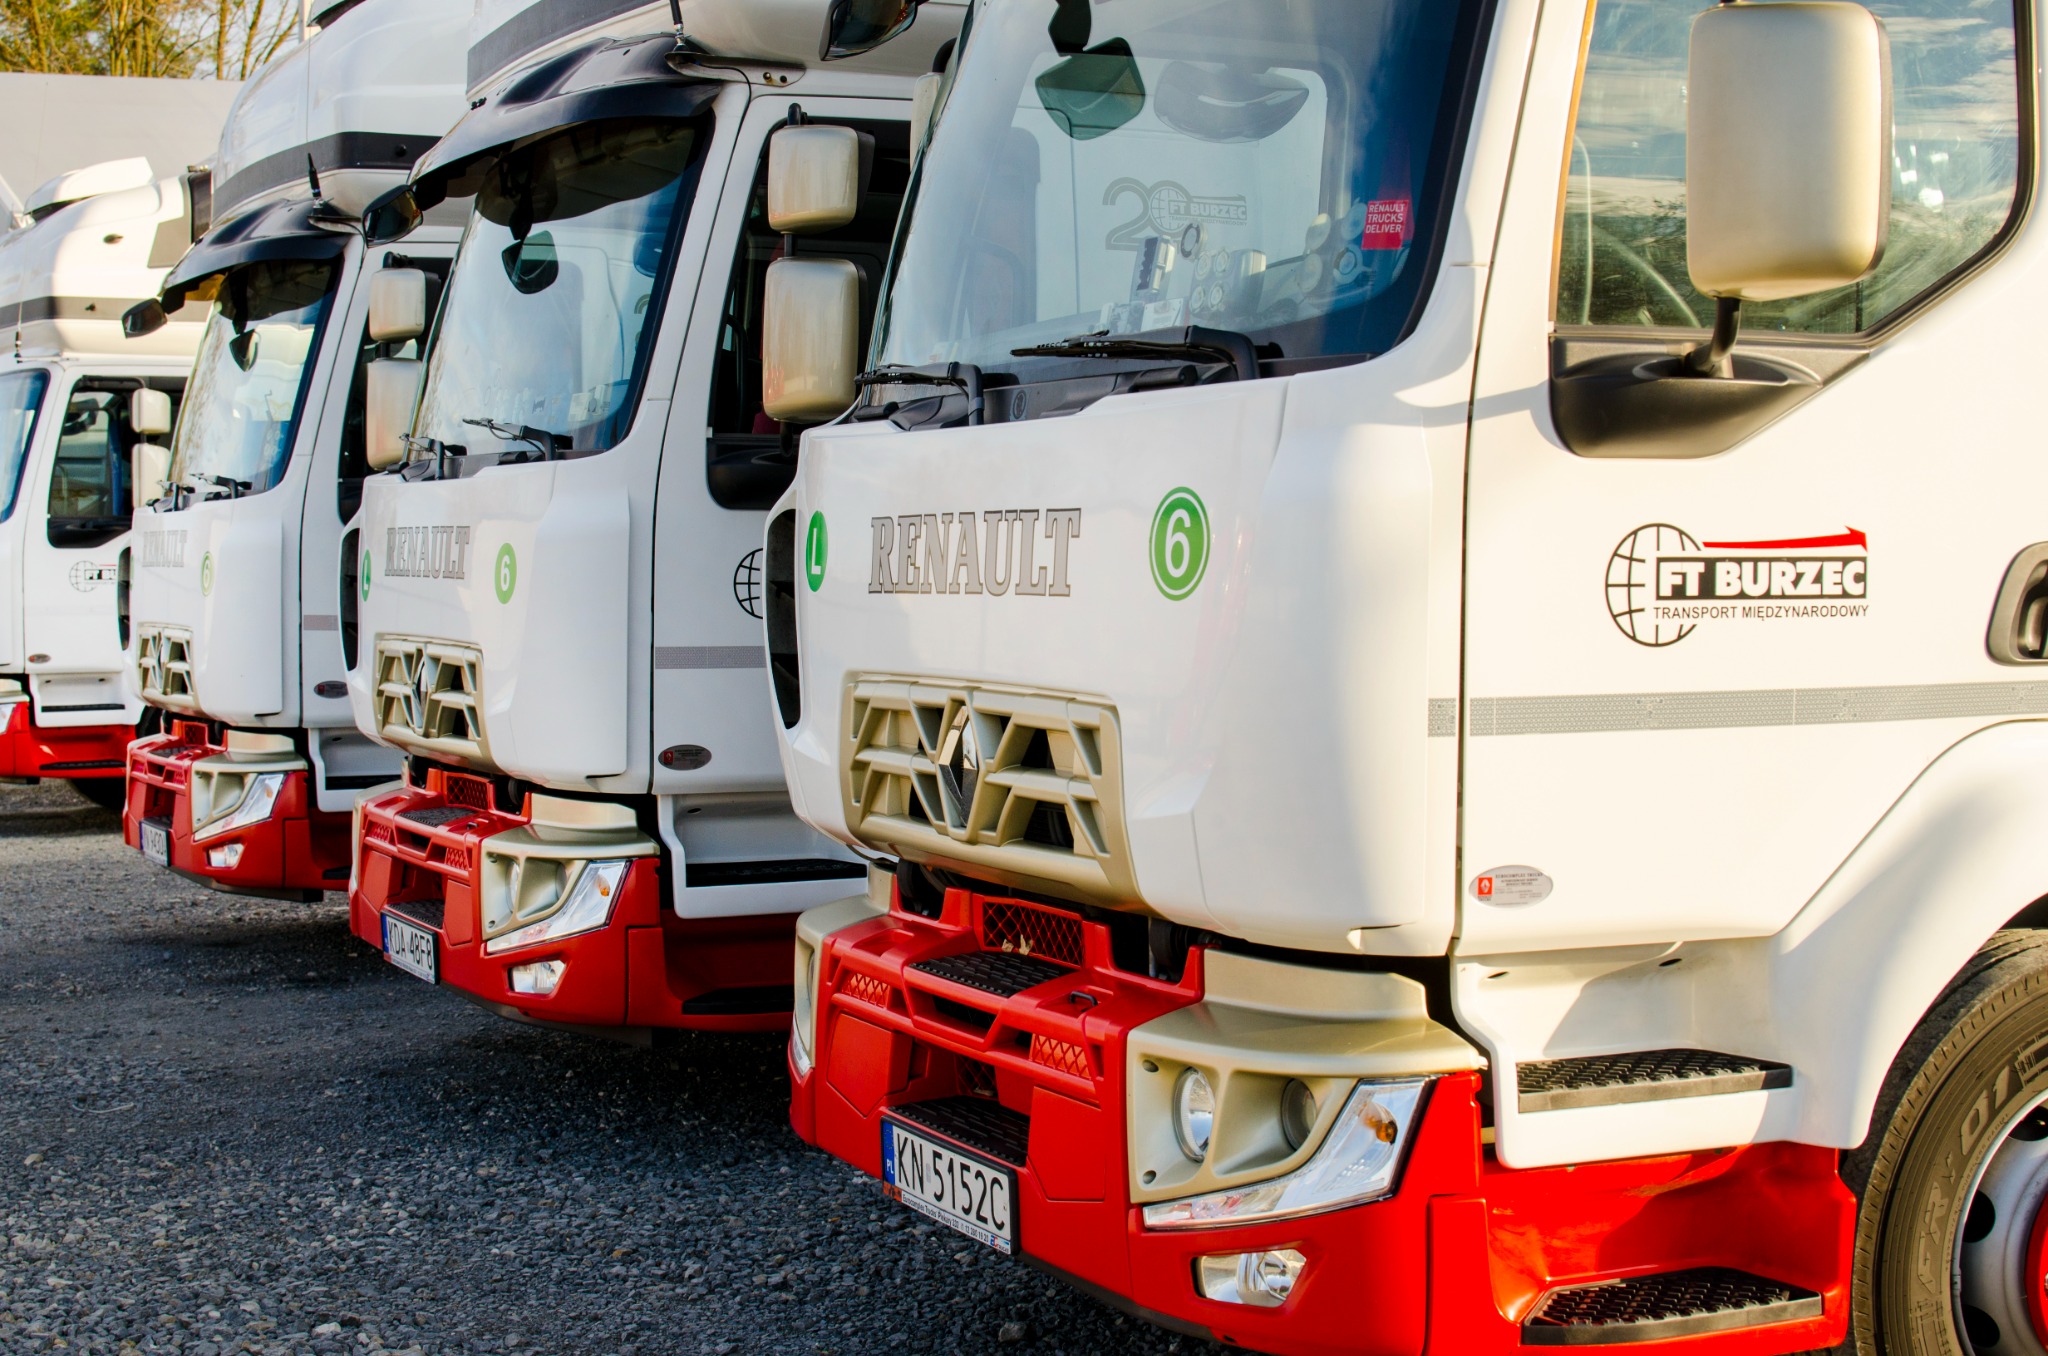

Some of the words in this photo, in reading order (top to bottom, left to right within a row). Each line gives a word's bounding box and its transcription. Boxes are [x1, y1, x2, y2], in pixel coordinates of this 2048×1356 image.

[1169, 202, 1187, 215] FT
[1190, 202, 1247, 219] BURZEC
[1367, 213, 1404, 223] TRUCKS
[1368, 203, 1406, 213] RENAULT
[1365, 224, 1402, 234] DELIVER
[384, 525, 471, 580] RENAULT
[810, 527, 822, 575] L
[868, 507, 1082, 597] RENAULT
[1164, 508, 1192, 578] 6
[500, 554, 511, 592] 6
[1658, 560, 1706, 597] FT
[1715, 560, 1866, 597] BURZEC
[1653, 606, 1738, 620] TRANSPORT
[1742, 604, 1870, 622] MIĘDZYNARODOWY
[388, 920, 407, 958] KDA
[410, 930, 433, 971] 48F8
[886, 1158, 894, 1175] PL
[897, 1132, 924, 1195] KN
[932, 1149, 1005, 1231] 5152C
